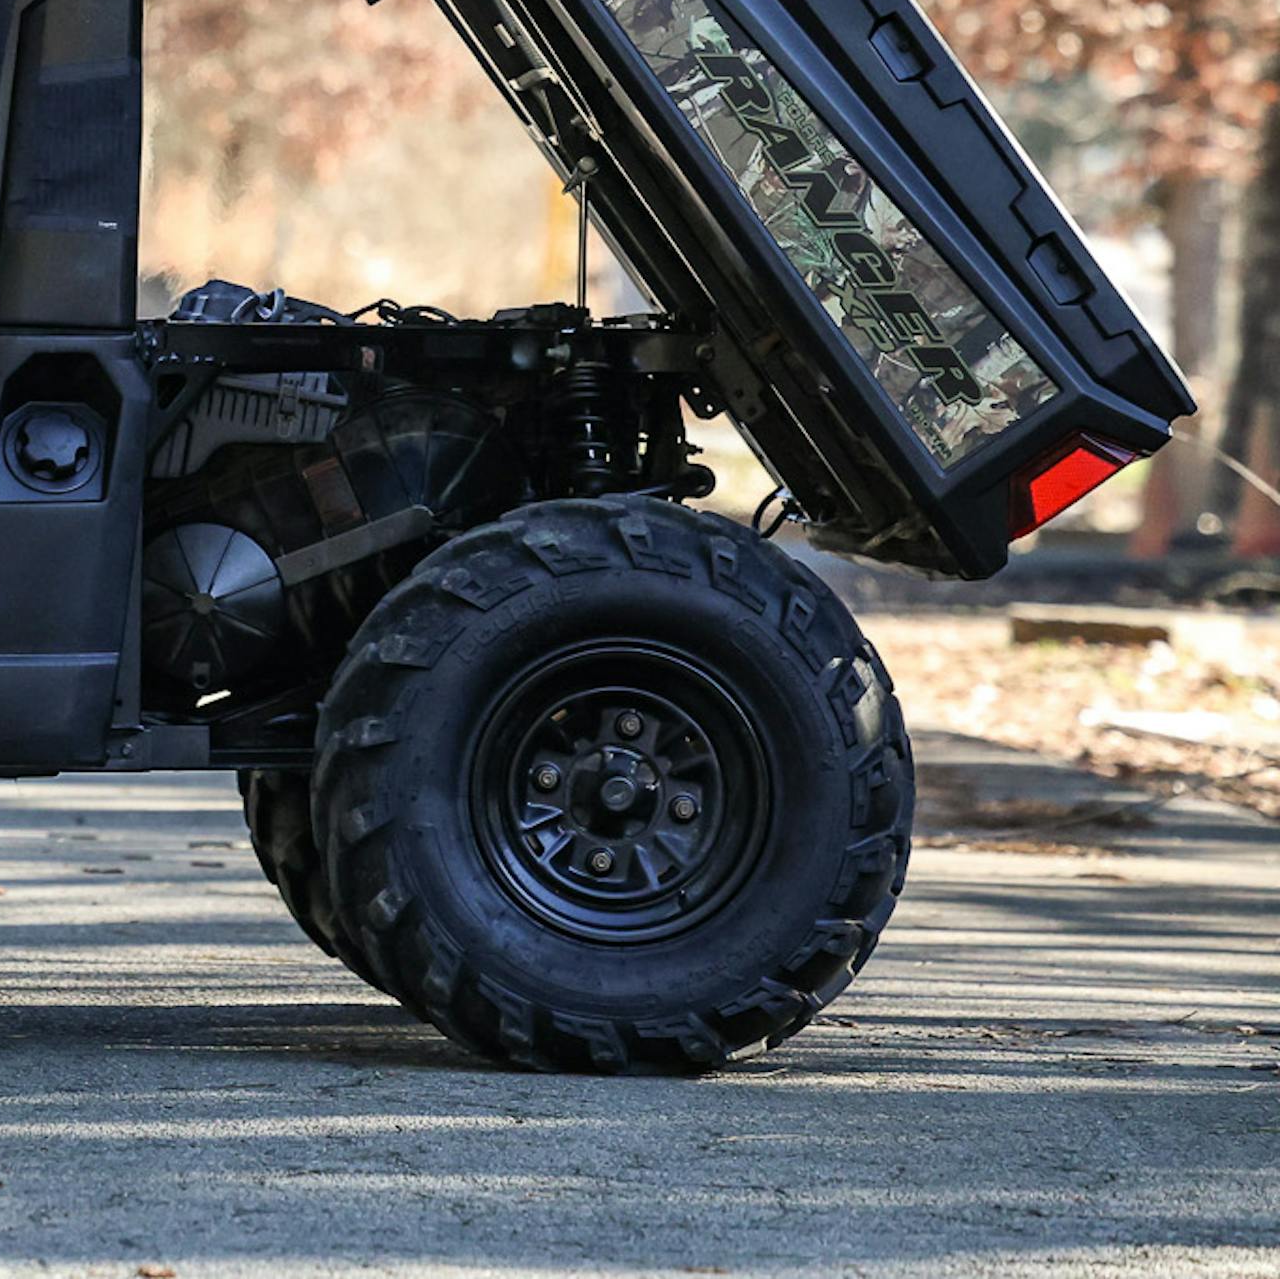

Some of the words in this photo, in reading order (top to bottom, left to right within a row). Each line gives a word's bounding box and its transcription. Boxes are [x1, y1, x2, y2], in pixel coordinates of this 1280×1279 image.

[778, 91, 835, 166] POLARIS
[695, 54, 984, 407] RANGER
[826, 282, 896, 353] XP
